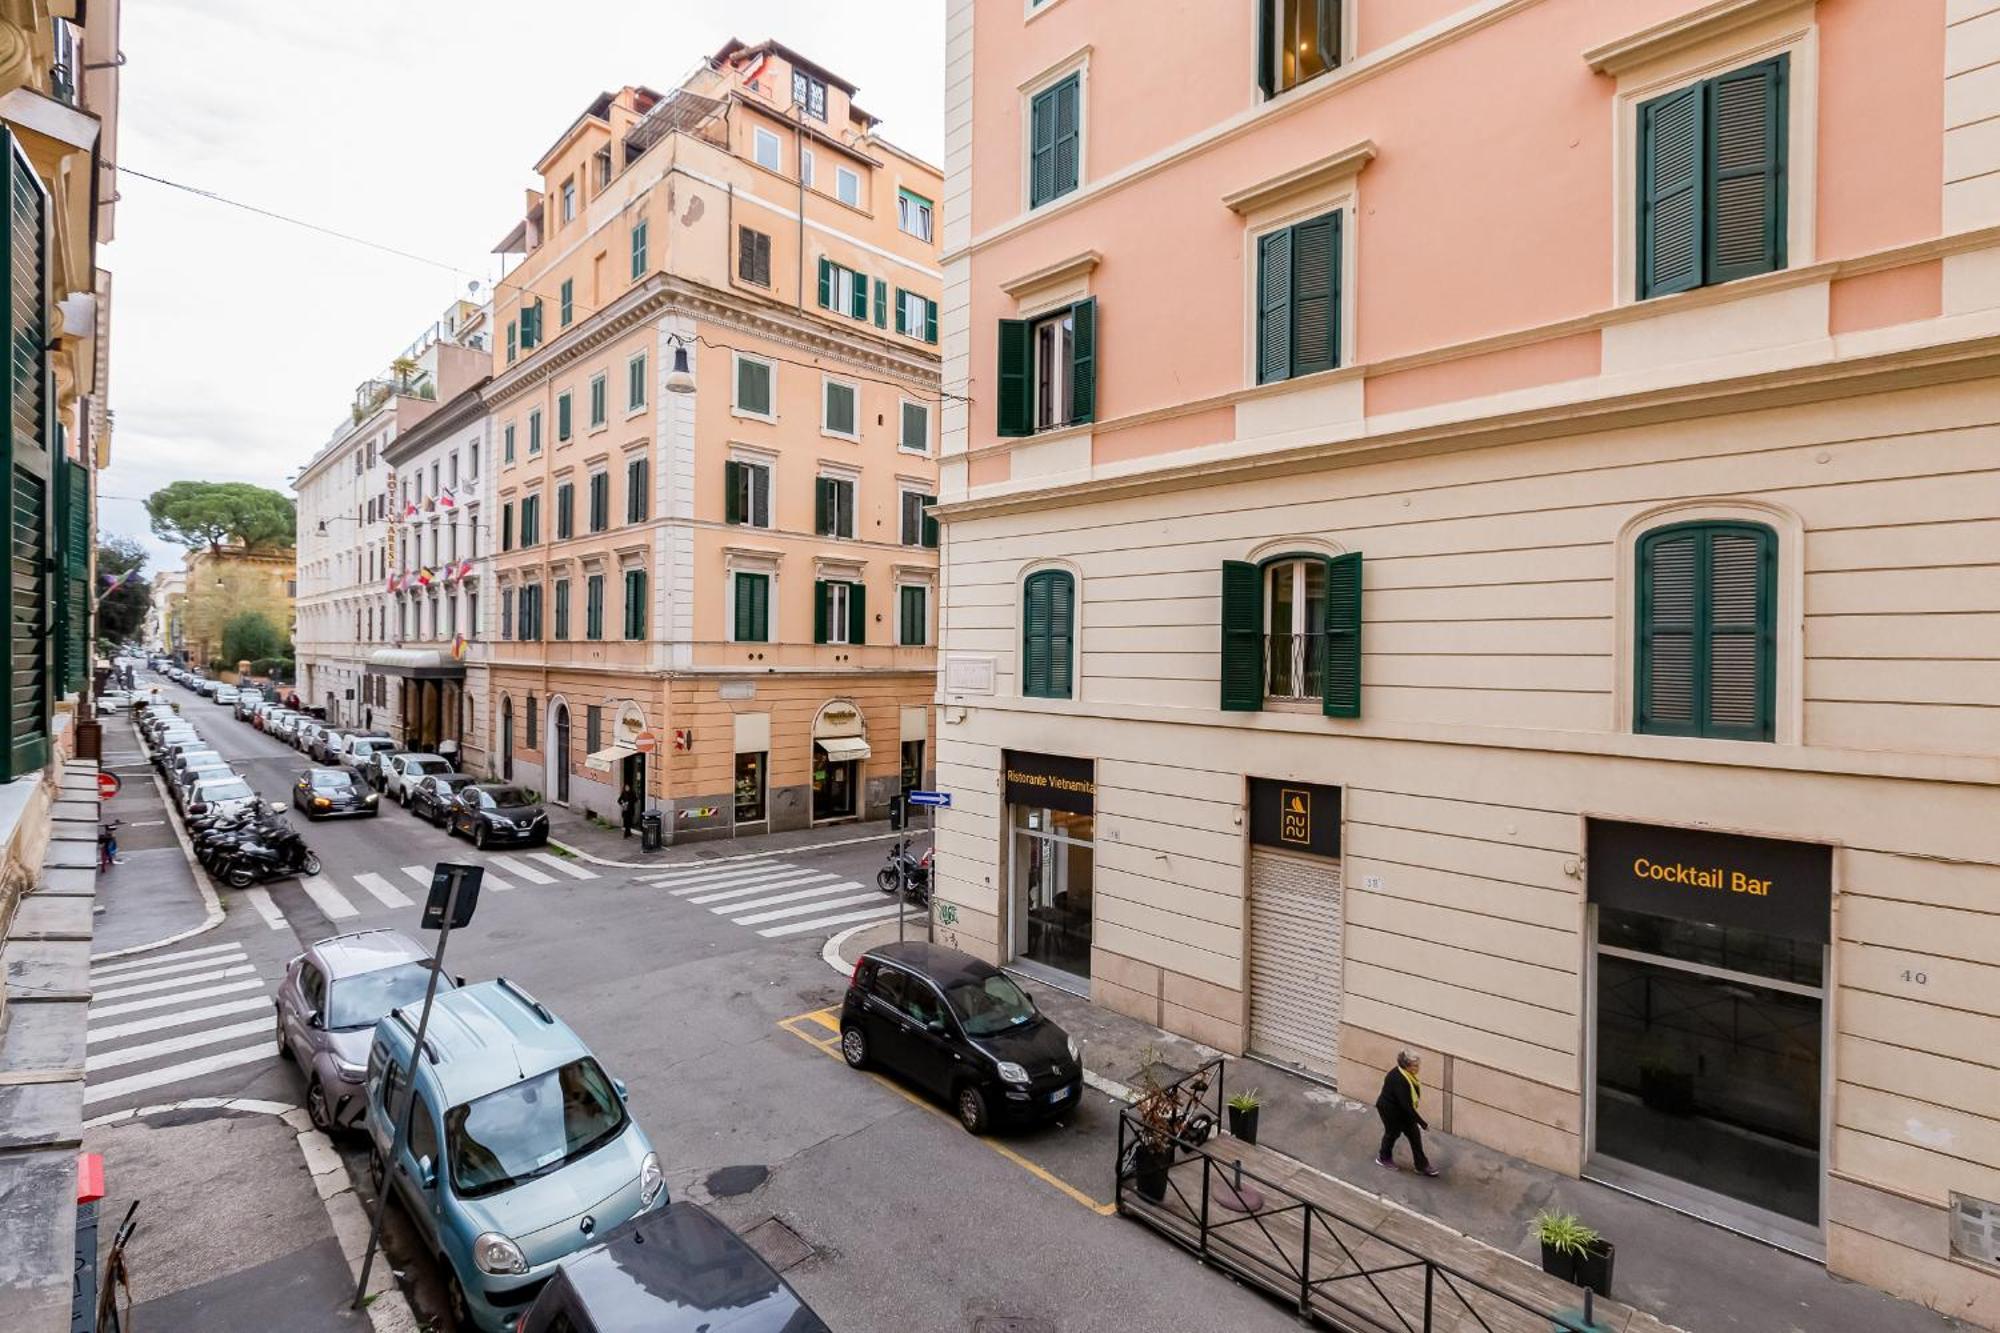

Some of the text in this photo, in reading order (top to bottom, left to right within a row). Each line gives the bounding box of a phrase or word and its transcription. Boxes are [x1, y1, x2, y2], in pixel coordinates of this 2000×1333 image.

[387, 472, 397, 569] HOTEL VARESE
[1007, 769, 1097, 795] Ristorante Vietnamita
[1286, 815, 1305, 827] nu
[1286, 826, 1305, 838] nu
[1634, 857, 1772, 896] Cocktail Bar
[1900, 969, 1927, 985] 40
